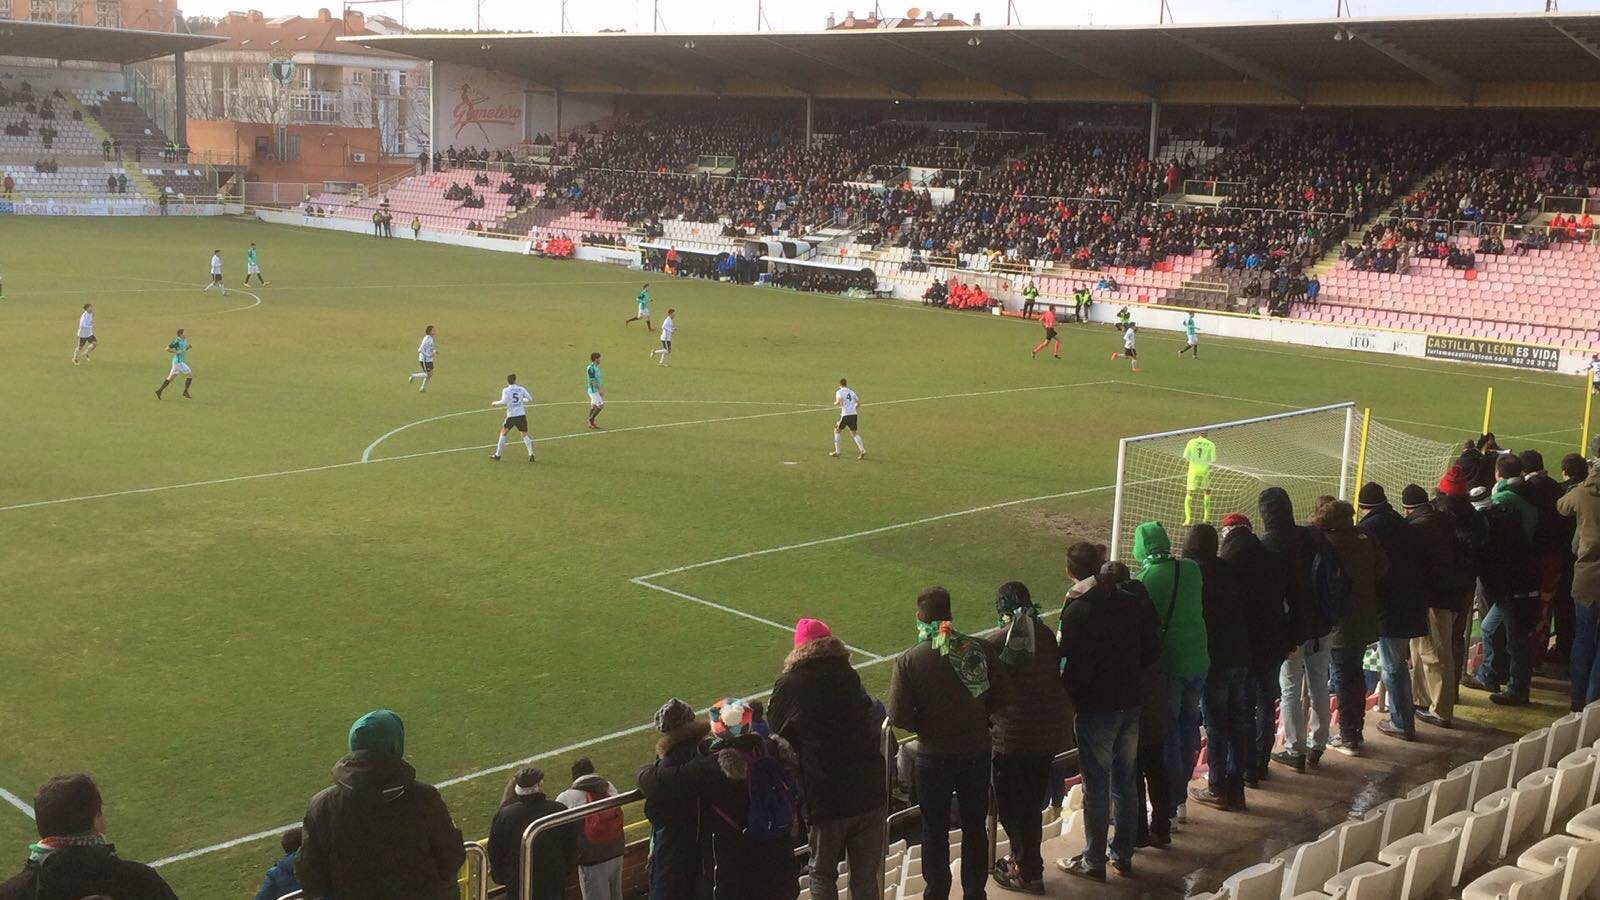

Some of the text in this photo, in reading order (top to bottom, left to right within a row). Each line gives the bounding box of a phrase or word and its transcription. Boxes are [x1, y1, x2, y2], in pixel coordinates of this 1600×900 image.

[1427, 337, 1558, 361] CASTILLA Y LEÓN ES VIDA
[512, 392, 520, 404] 5
[846, 392, 852, 402] 4
